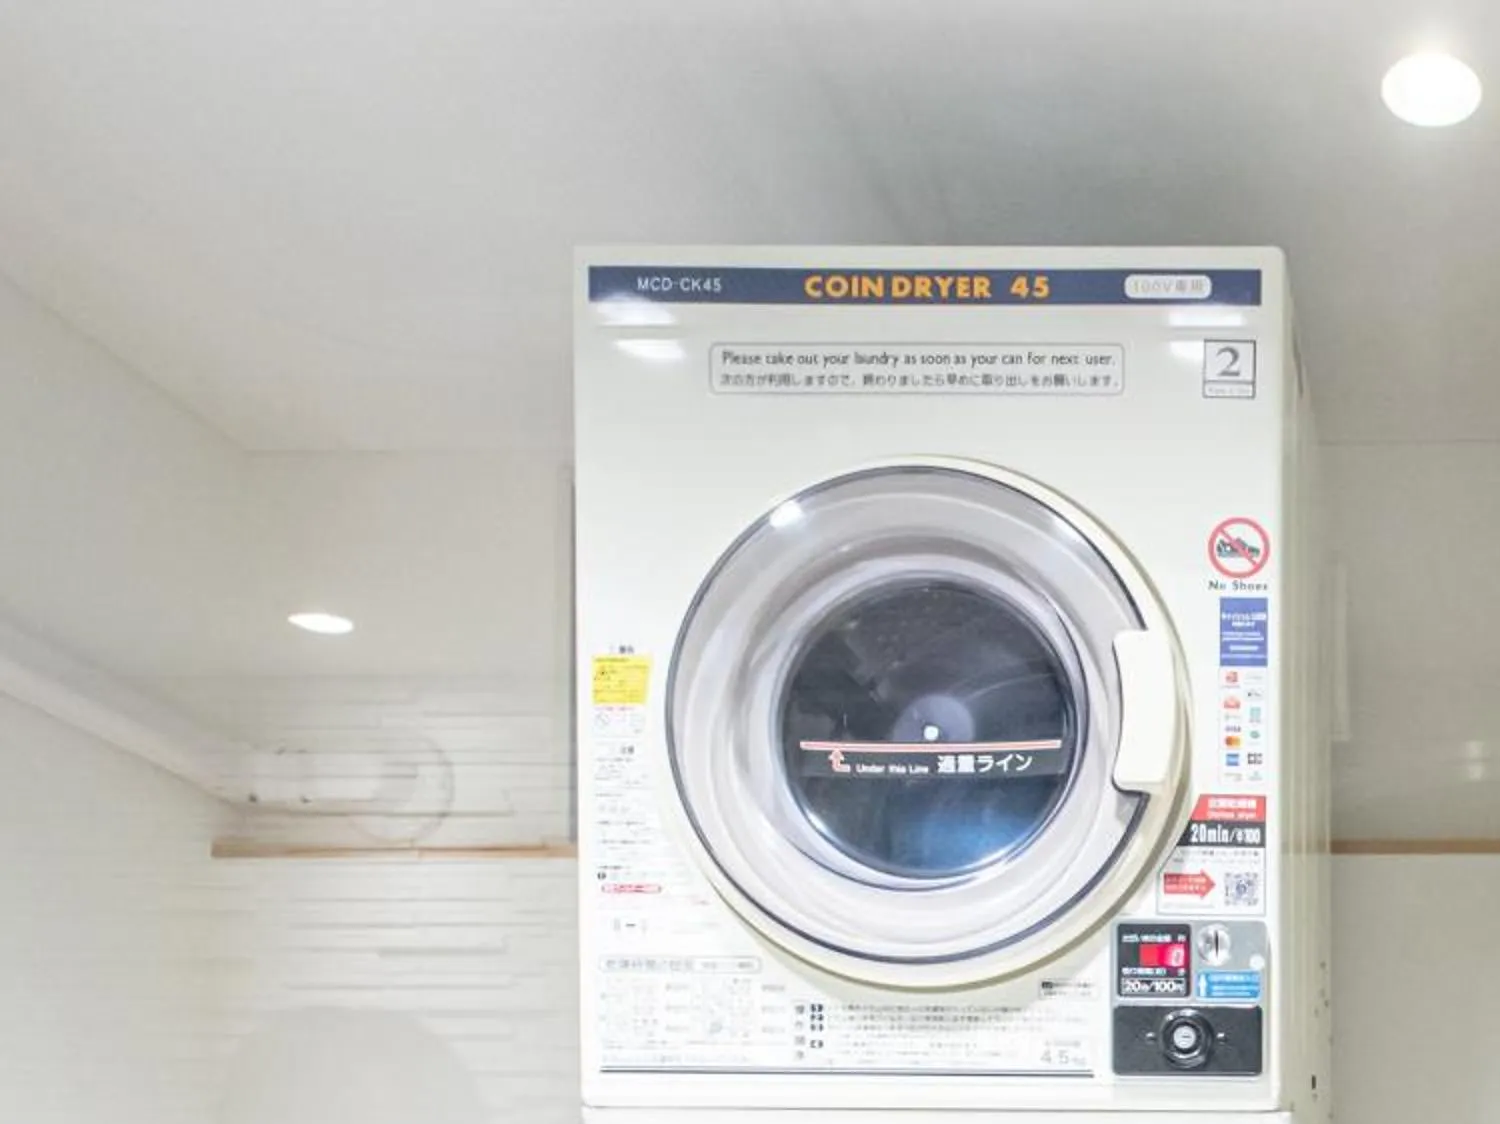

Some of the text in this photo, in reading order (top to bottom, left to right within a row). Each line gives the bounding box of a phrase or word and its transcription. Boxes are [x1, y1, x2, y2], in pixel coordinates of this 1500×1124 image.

[637, 277, 722, 293] MCD-CK45
[804, 275, 1051, 299] COIN DRYER 45
[722, 351, 1116, 369] Please take out your laundry as soon as your can for next user.
[1216, 346, 1241, 376] 2
[1208, 580, 1227, 591] No
[937, 754, 1033, 774] 適量ライン
